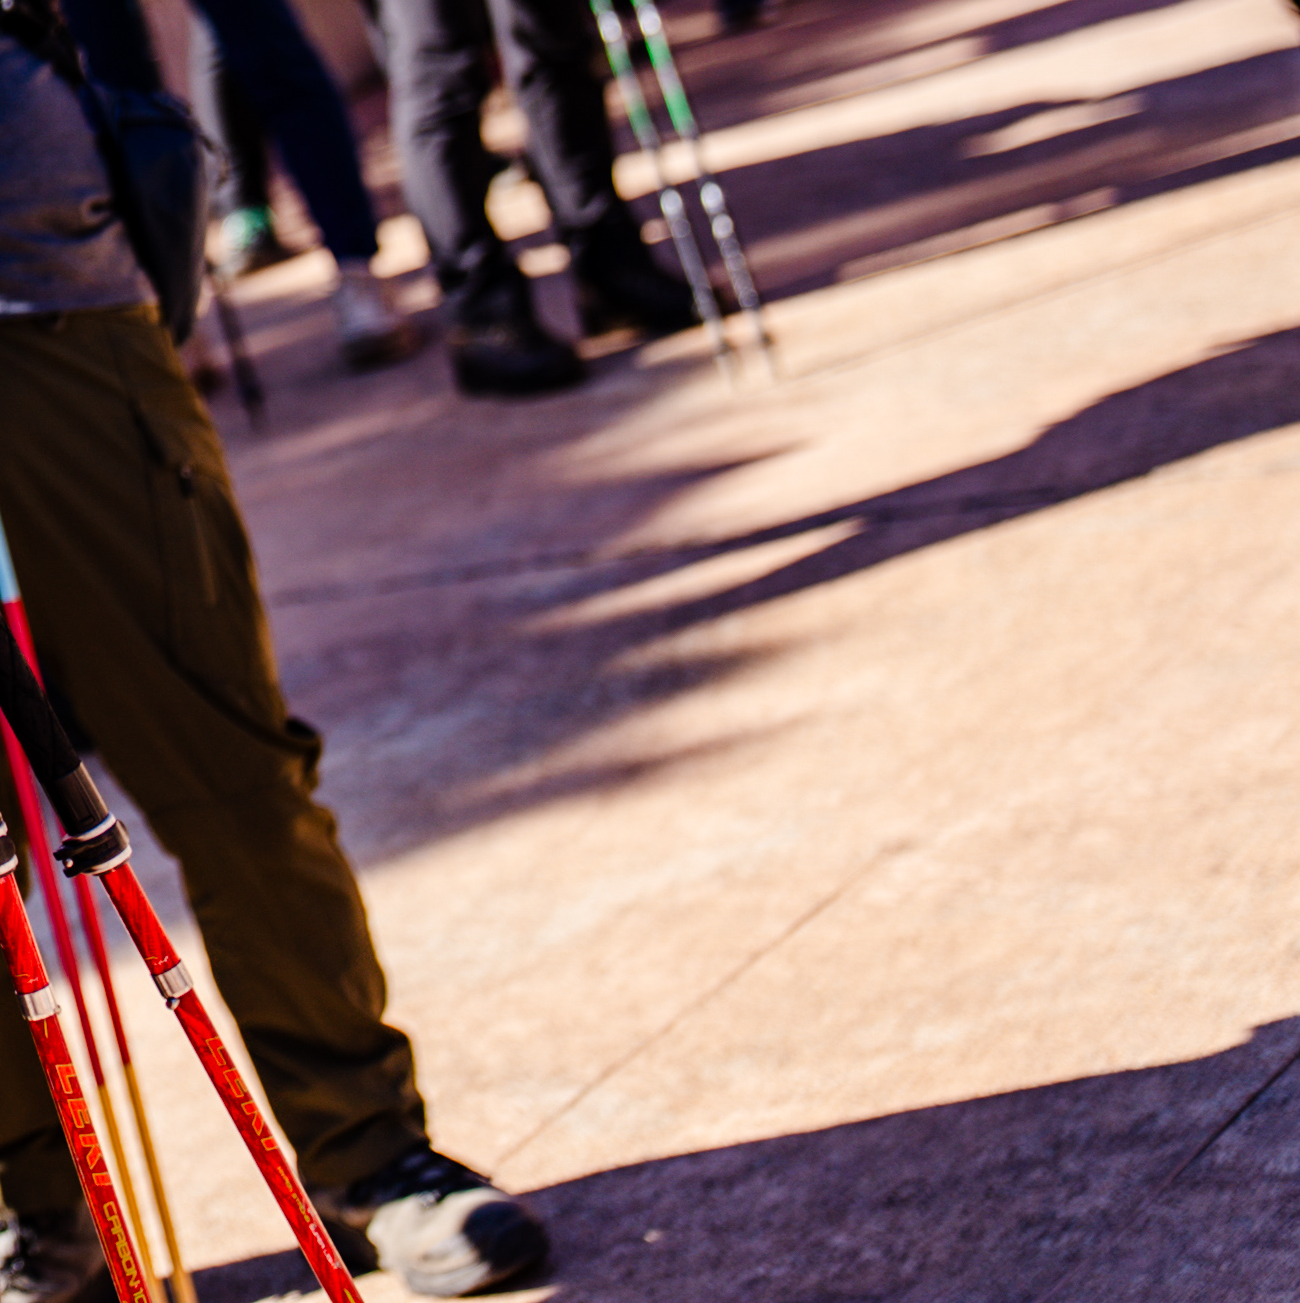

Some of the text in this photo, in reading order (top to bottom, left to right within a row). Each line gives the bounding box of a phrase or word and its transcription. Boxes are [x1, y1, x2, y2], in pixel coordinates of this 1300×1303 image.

[55, 1062, 114, 1187] LEKI
[205, 1035, 279, 1152] LEKI
[102, 1200, 139, 1289] CARBON
